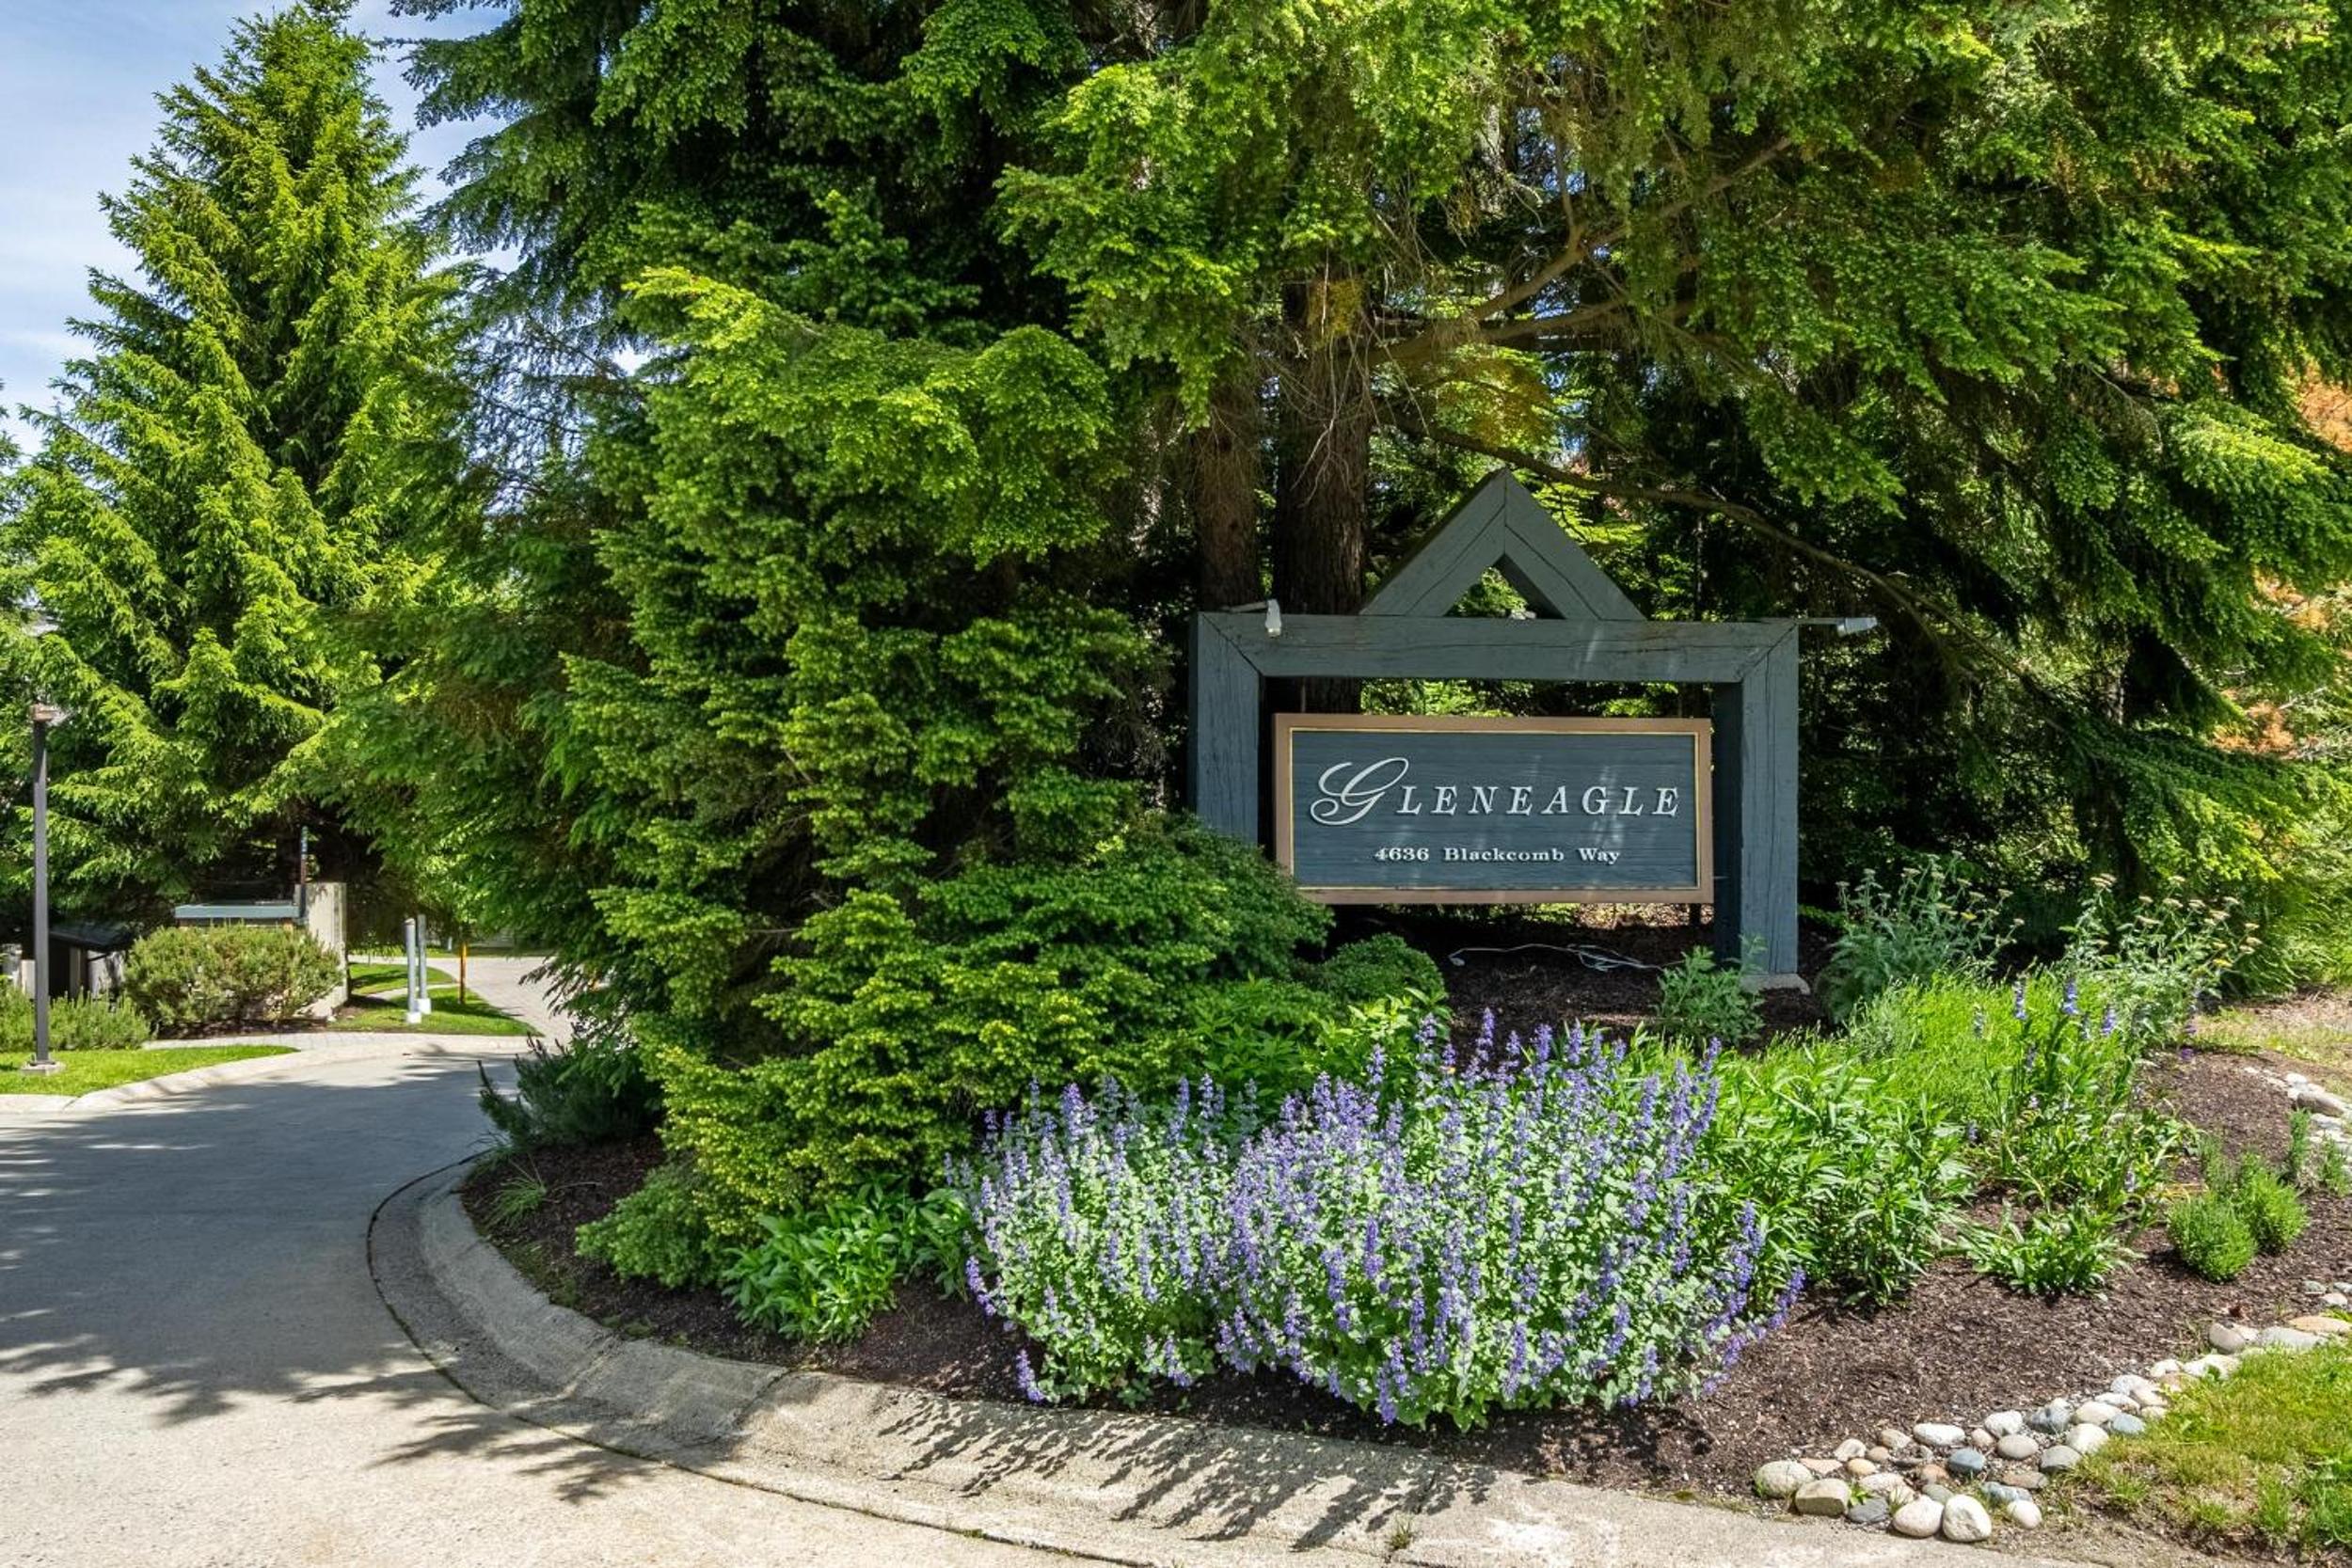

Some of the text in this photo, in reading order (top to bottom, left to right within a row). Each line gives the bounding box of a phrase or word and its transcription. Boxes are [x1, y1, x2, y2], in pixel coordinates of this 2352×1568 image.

[1310, 757, 1678, 825] GLENEAGLE
[1374, 847, 1620, 864] 4636 Blackcomb Way
